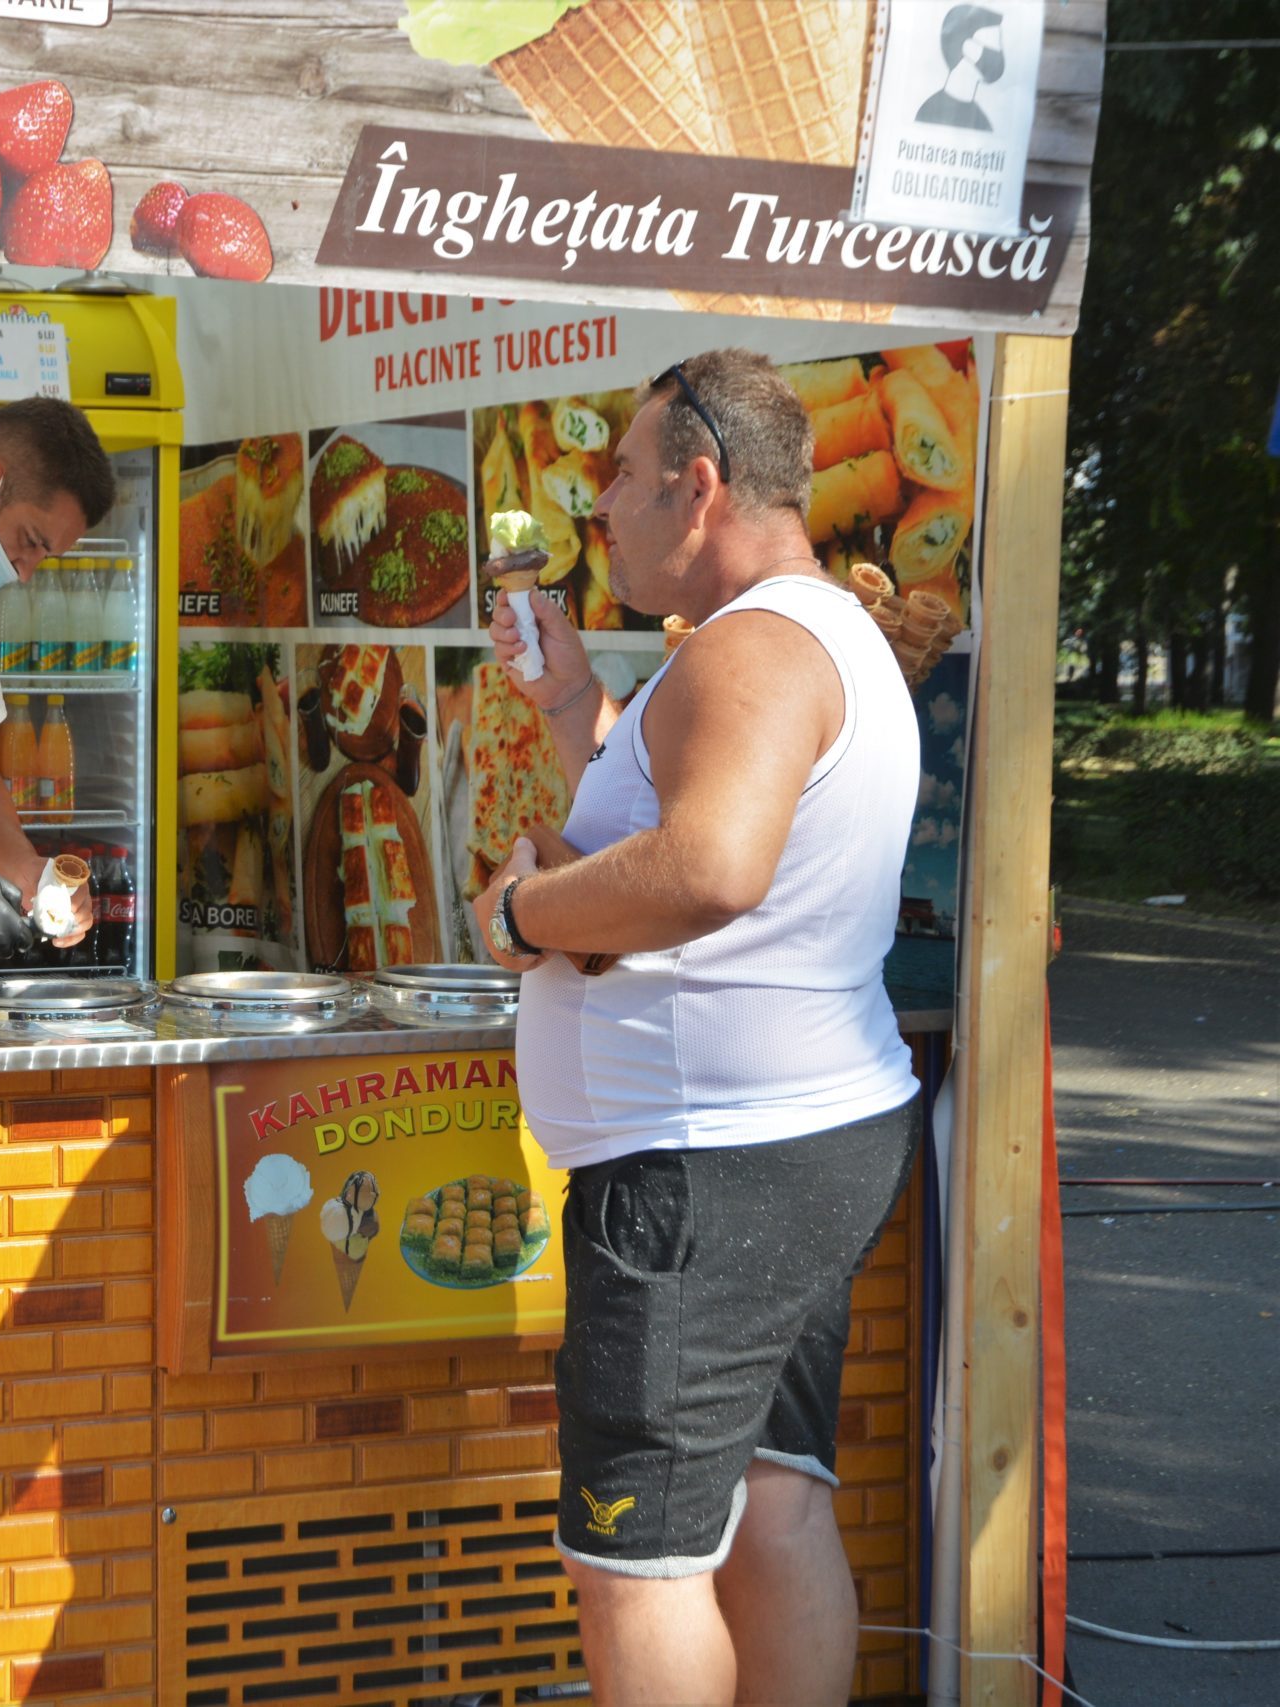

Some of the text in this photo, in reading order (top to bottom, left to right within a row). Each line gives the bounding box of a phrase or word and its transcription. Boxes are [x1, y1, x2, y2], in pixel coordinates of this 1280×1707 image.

[891, 170, 1003, 209] OBLIGATORIE!
[723, 193, 1054, 282] Turcească
[44, 331, 55, 340] LEI
[46, 357, 57, 366] LEI
[375, 315, 617, 392] PLACINTE TURCESTI
[320, 593, 358, 613] KUNEFE
[207, 907, 257, 927] BORE
